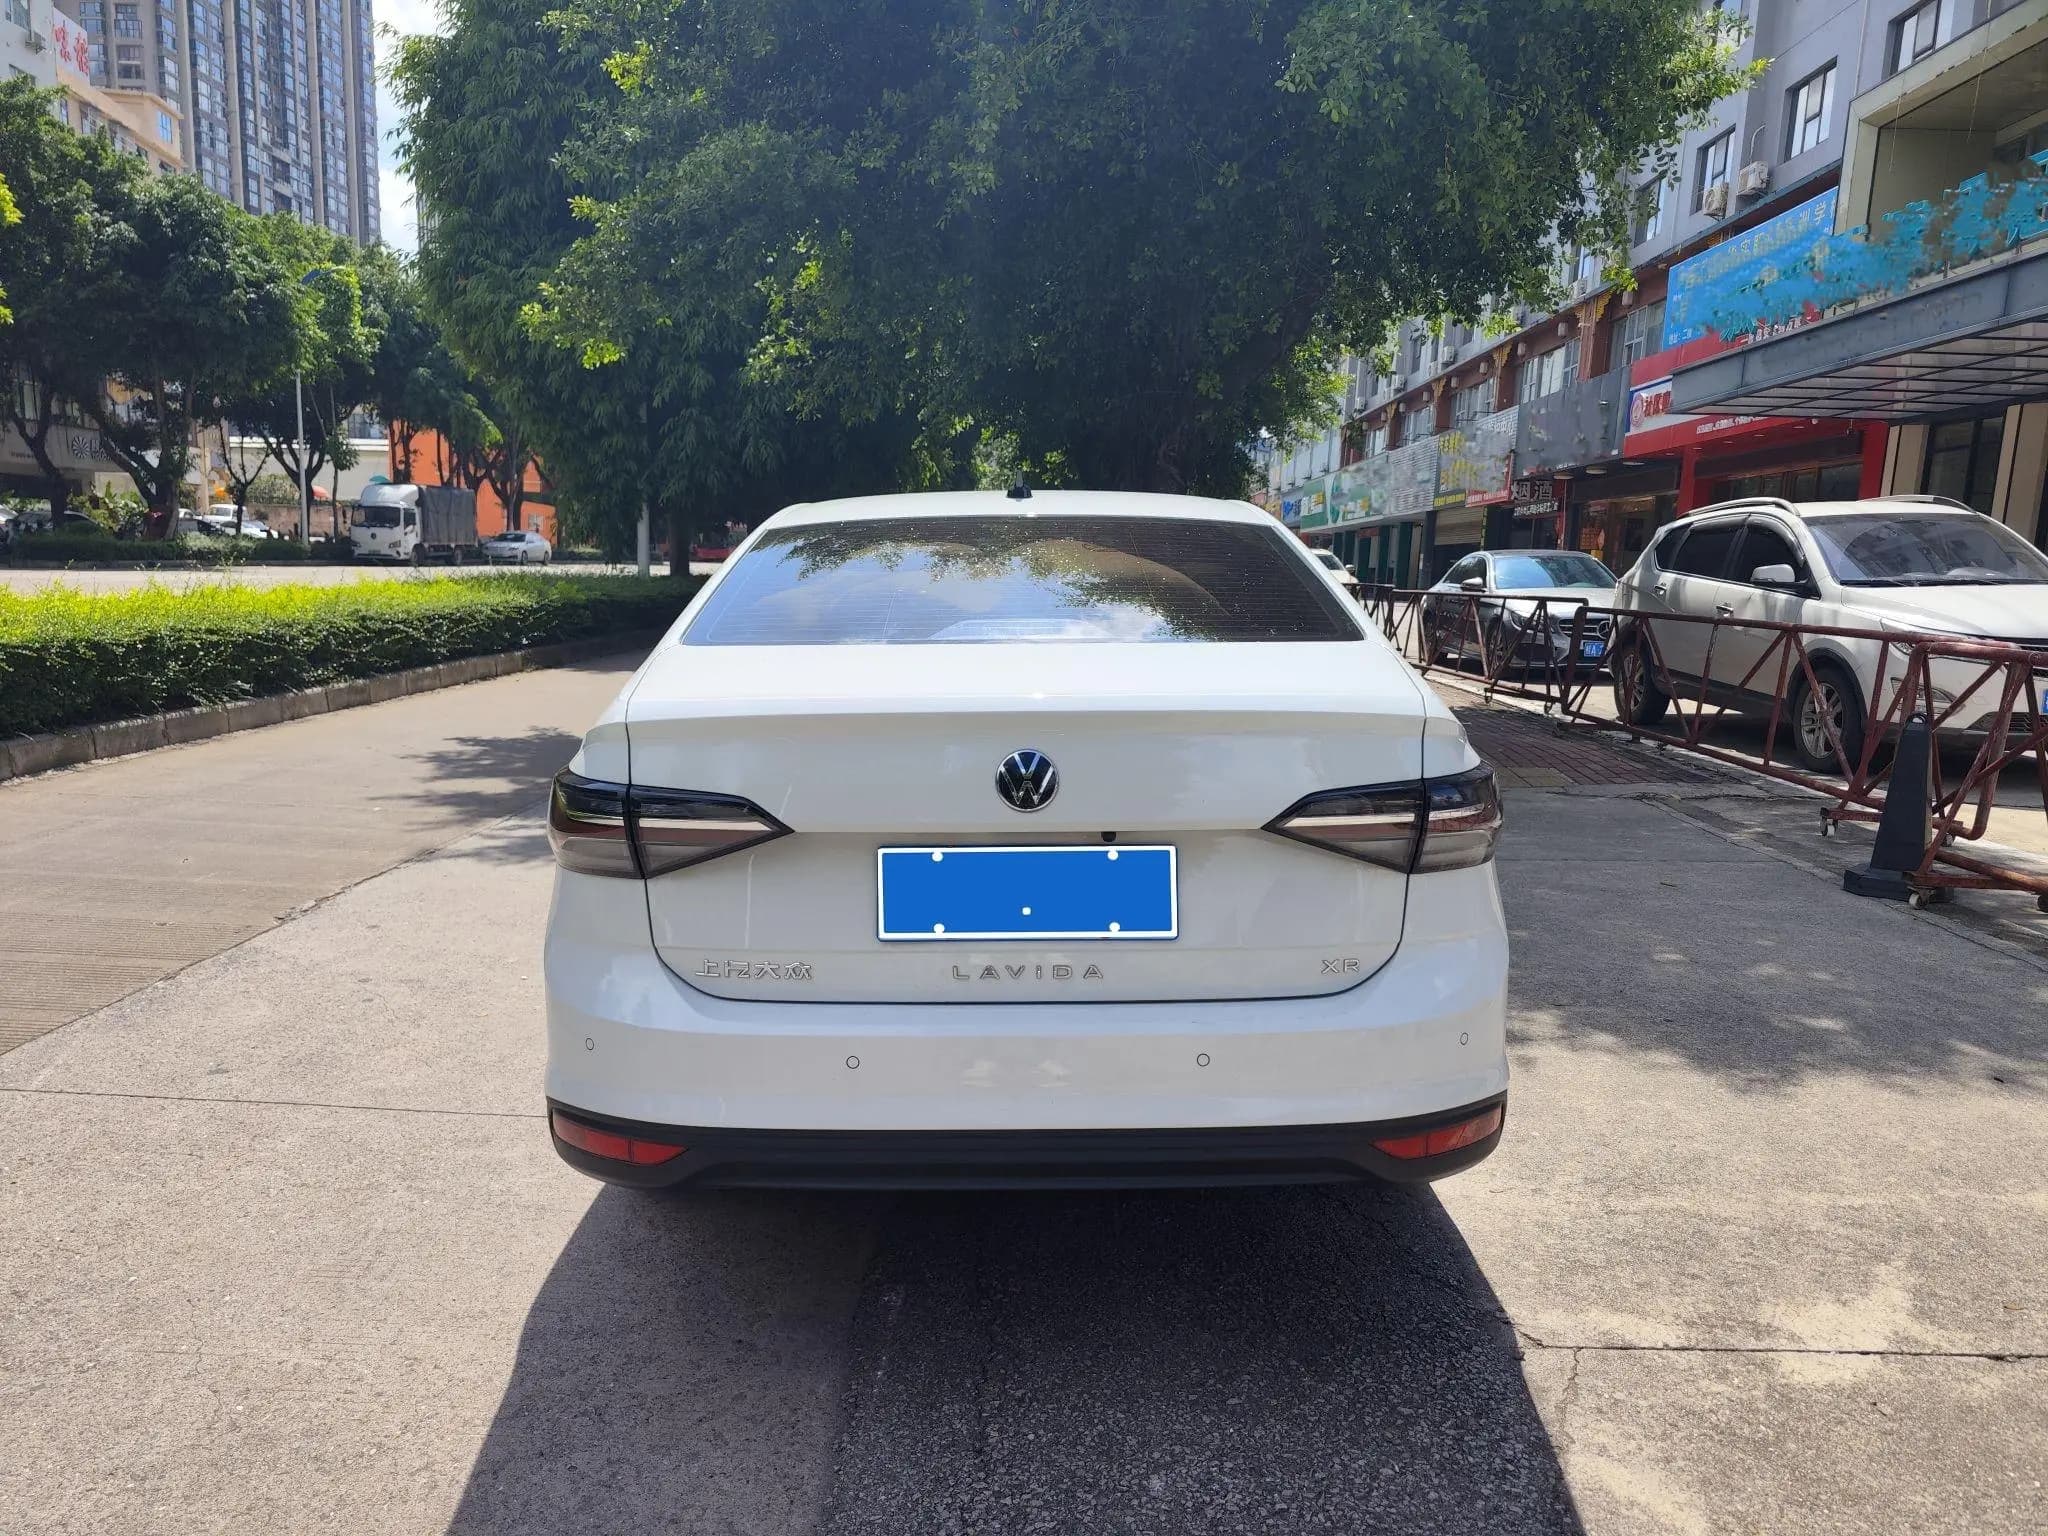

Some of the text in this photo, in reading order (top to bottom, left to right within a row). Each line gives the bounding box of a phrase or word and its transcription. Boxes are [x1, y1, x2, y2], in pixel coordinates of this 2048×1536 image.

[1511, 480, 1553, 502] 烟酒
[695, 959, 812, 980] 上汽大众
[952, 964, 1104, 980] LAVIDA
[1320, 958, 1360, 974] XR
